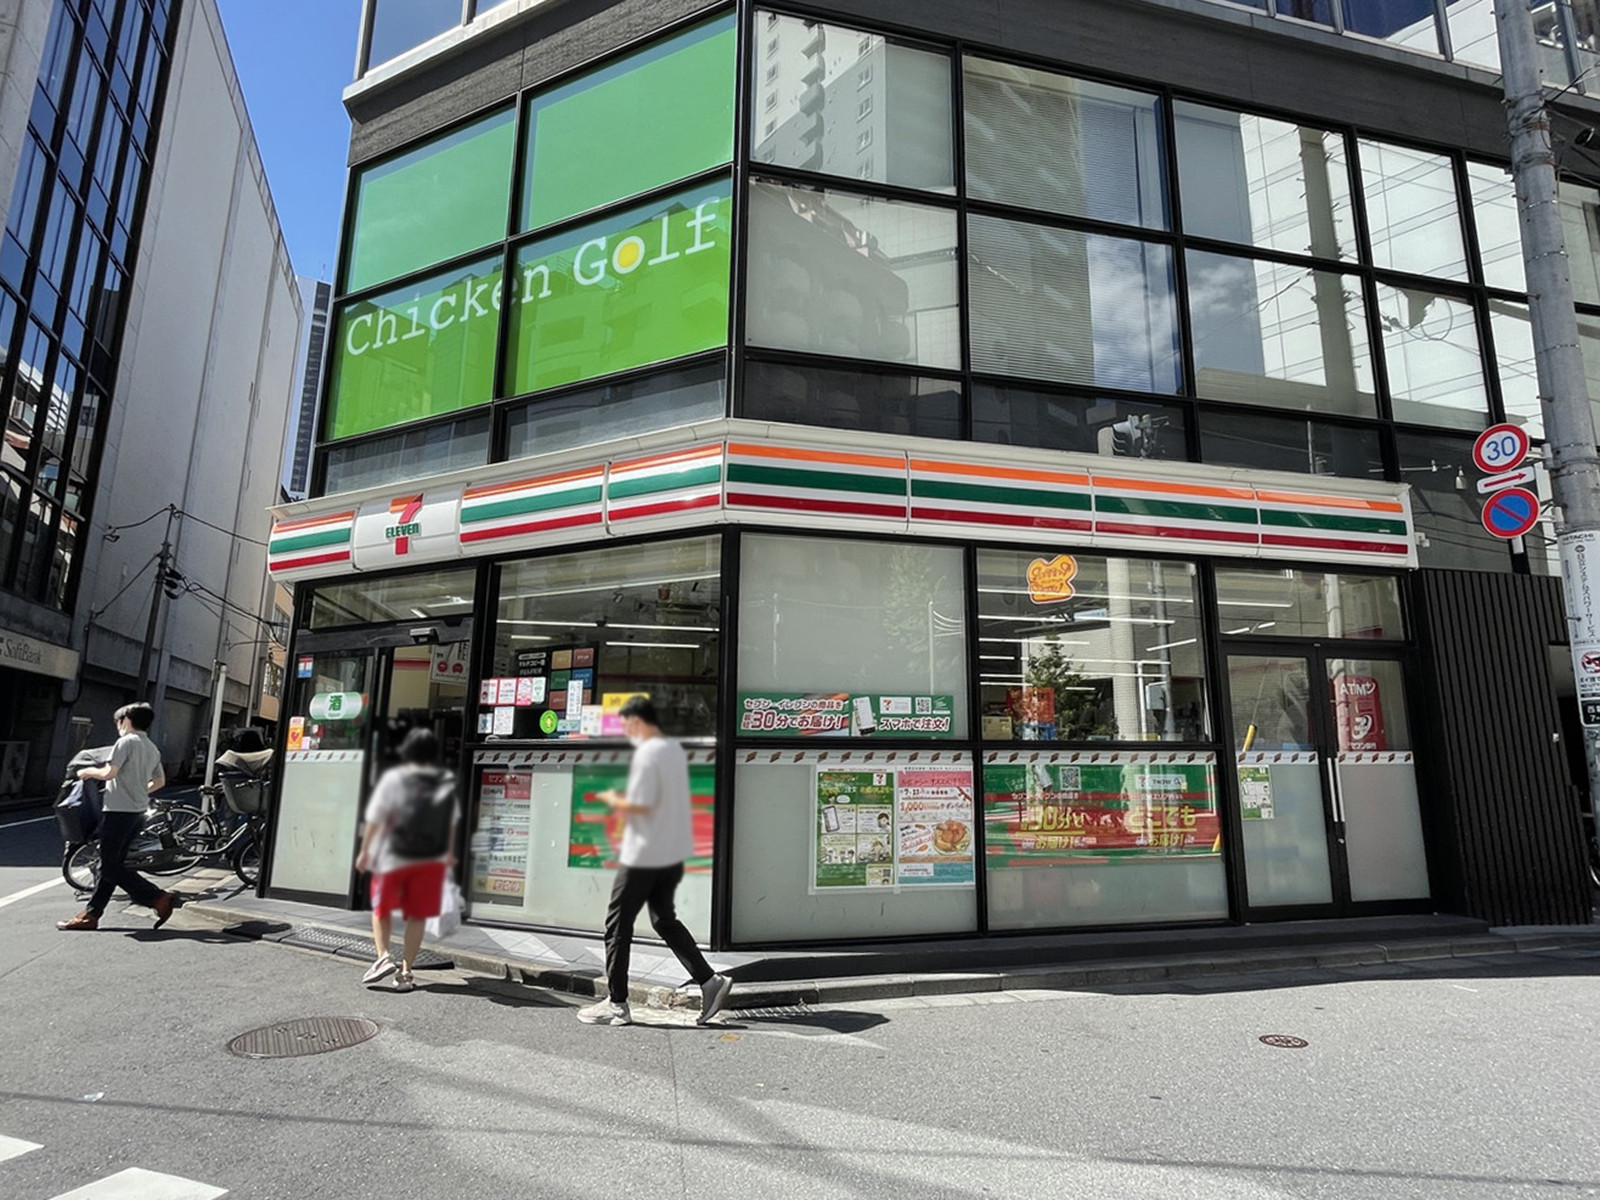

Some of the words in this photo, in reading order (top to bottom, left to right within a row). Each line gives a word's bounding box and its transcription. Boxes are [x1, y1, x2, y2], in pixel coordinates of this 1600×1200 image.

[346, 265, 552, 356] Chicken
[573, 196, 720, 287] Golf
[1486, 436, 1516, 461] 30
[1562, 533, 1594, 541] HITACHI
[3, 638, 41, 665] SoftBank
[328, 695, 343, 711] 酒
